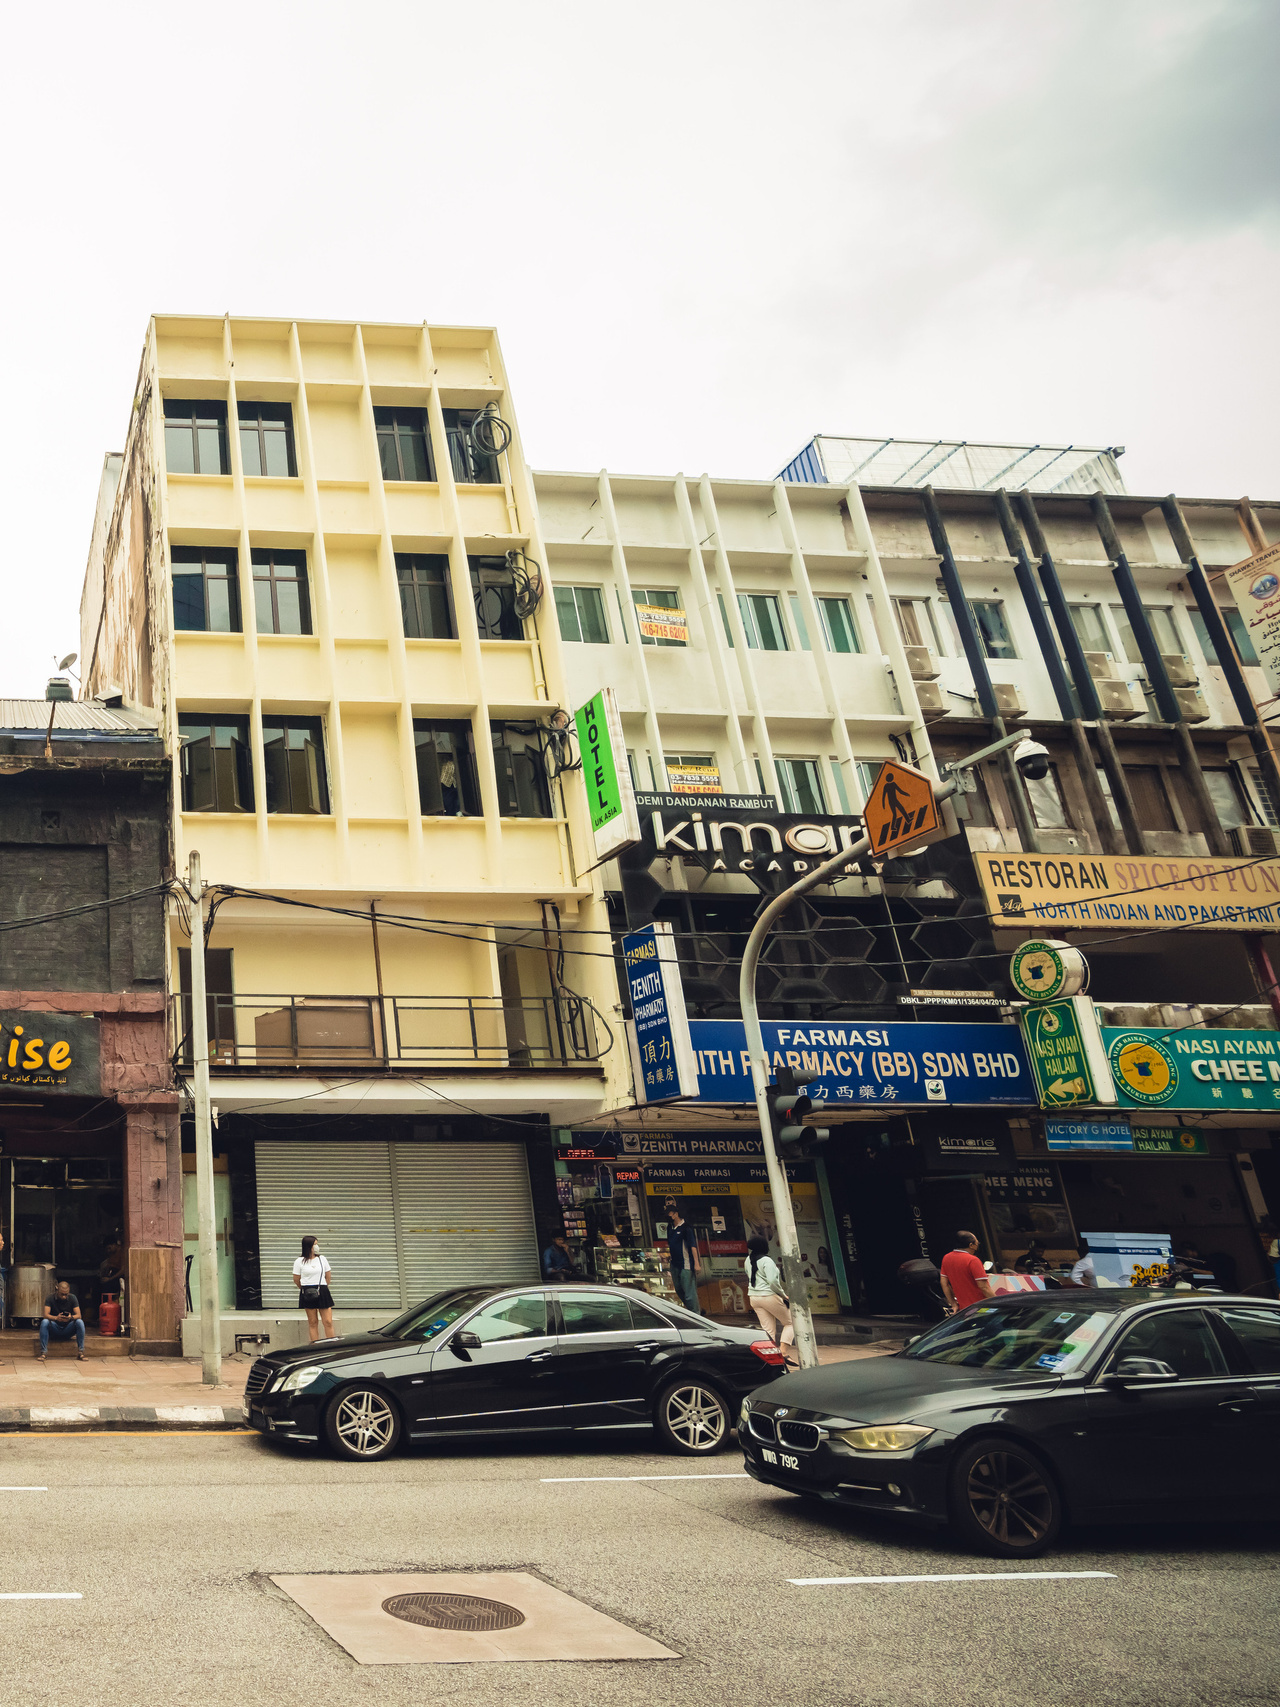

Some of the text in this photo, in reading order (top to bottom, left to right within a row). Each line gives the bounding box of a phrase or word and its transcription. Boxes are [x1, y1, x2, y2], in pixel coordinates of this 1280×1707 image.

[1229, 561, 1255, 578] SHAWKY
[1255, 548, 1280, 563] TRAVEL
[669, 626, 686, 640] 6201
[584, 701, 608, 809] HOTEL
[634, 795, 774, 809] DEMI DANDANAN RAMBUT
[594, 806, 618, 827] UK ASIA
[713, 858, 884, 875] ACADMY
[988, 860, 1110, 890] RESTORAN
[1114, 862, 1186, 891] SPICE
[1187, 863, 1221, 892] OF
[1032, 901, 1275, 923] NORTH INDIAN AND PAKISTANI
[627, 940, 656, 967] FARMASI
[631, 971, 662, 1001] ZENITH
[647, 1019, 658, 1029] SDN
[657, 1016, 668, 1026] BHD
[777, 1029, 890, 1047] FARMASI
[1034, 1035, 1079, 1058] NASI AYAM
[642, 1035, 671, 1065] 頂力
[1175, 1040, 1276, 1055] NASI AYAM
[872, 1051, 919, 1083] (BB)
[924, 1052, 970, 1078] SDN
[976, 1052, 1020, 1078] BHD
[1045, 1056, 1078, 1076] HAILAM
[1191, 1059, 1268, 1082] CHEE
[1048, 1125, 1131, 1136] VICTORY G HOTEL
[1151, 1129, 1173, 1139] AYAM
[641, 1140, 764, 1153] ZENITH PHARMACY
[938, 1136, 995, 1147] kimarie
[1138, 1141, 1171, 1151] HAILAM
[616, 1171, 640, 1181] REPAIR
[648, 1169, 686, 1177] FARMASI
[694, 1169, 731, 1177] FARMASI
[984, 1177, 1054, 1188] HEE MENG
[779, 1453, 800, 1471] 7912
